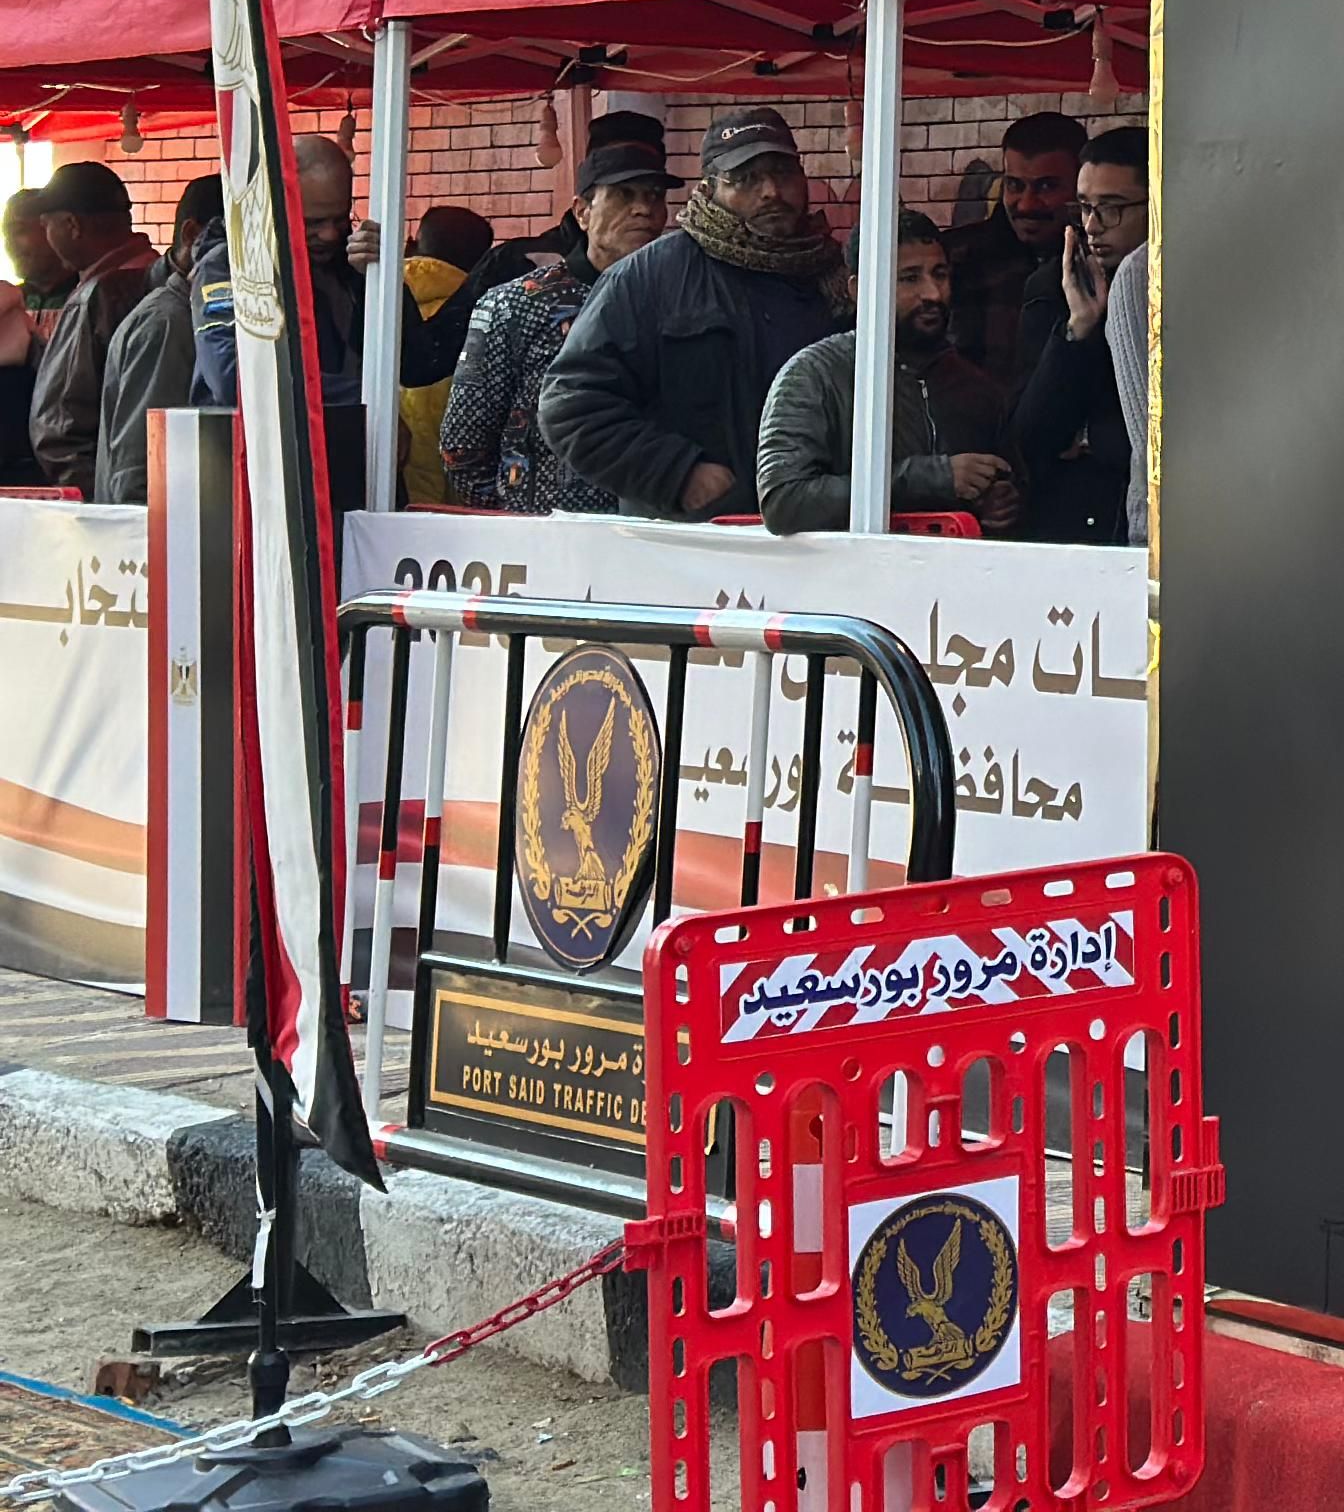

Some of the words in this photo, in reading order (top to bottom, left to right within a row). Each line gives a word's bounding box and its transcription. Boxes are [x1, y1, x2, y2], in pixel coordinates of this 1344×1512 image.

[933, 951, 1021, 999] مرور
[1029, 925, 1114, 980] إدارة
[741, 964, 919, 1020] بورسعيد
[467, 1020, 565, 1071] بورسعيد
[567, 1039, 628, 1077] مرور
[463, 1065, 503, 1094] PORT
[509, 1074, 545, 1105] SAID
[553, 1083, 623, 1121] TRAFFIC
